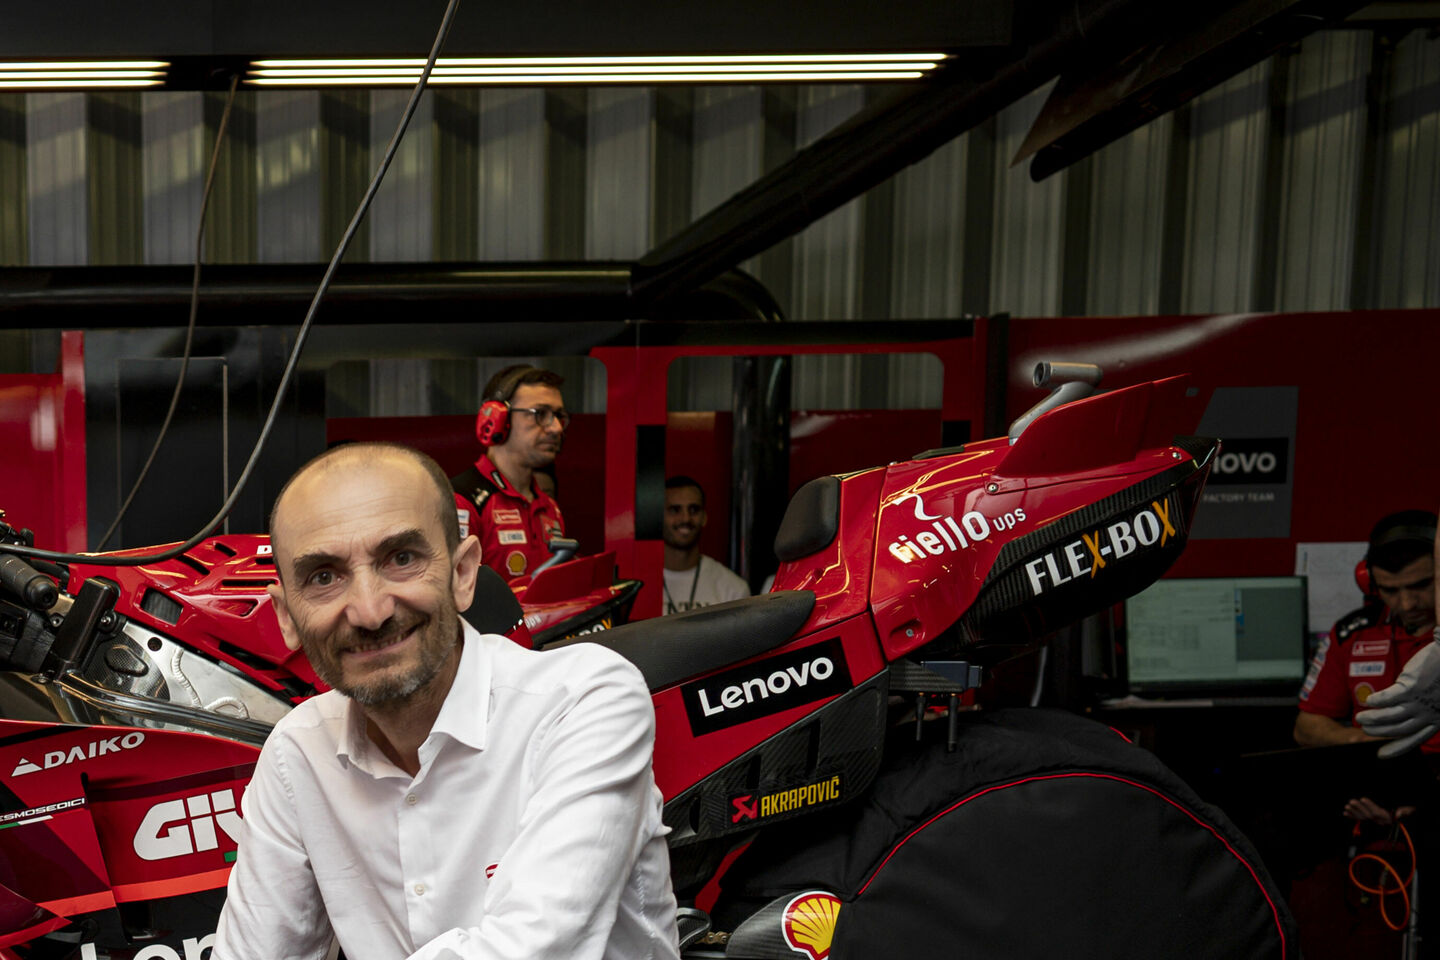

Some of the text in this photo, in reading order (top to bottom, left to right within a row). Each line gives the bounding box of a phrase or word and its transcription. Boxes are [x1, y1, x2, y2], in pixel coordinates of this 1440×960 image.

[1025, 498, 1176, 597] FLEX-BOX
[698, 656, 834, 717] Lenovo
[43, 731, 146, 770] DAIKO
[760, 775, 840, 817] AKRAPOVIČ
